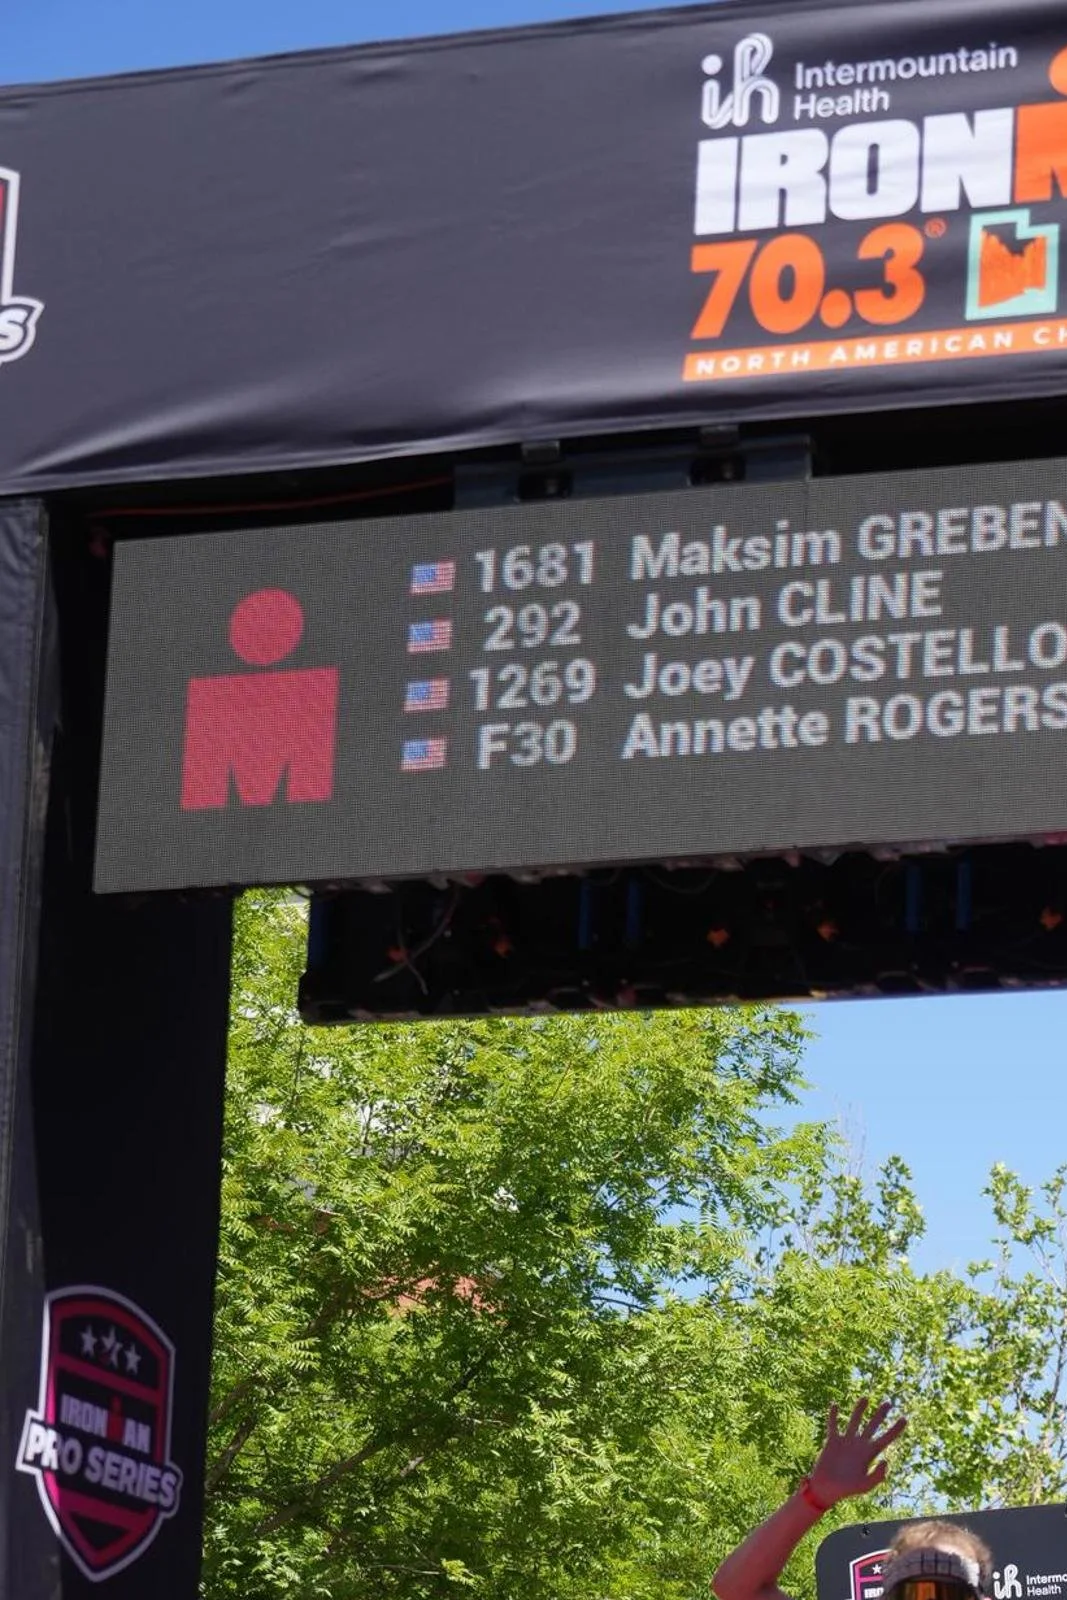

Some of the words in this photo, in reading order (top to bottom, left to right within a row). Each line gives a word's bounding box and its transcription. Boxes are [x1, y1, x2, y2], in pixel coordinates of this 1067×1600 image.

[794, 43, 1018, 90] Intermountain
[793, 88, 890, 120] Health
[690, 223, 925, 341] 70.3
[696, 349, 811, 376] NORTH
[829, 329, 1014, 364] AMERICAN
[475, 541, 596, 594] 1681
[629, 521, 841, 581] Maksim
[483, 601, 582, 653] 292
[626, 578, 760, 641] John
[777, 569, 944, 627] CLINE
[468, 659, 596, 712] 1269
[624, 651, 755, 704] Joey
[476, 720, 577, 771] F30
[621, 701, 830, 761] Annette
[61, 1393, 151, 1453] IRONMAN
[25, 1422, 83, 1476] PRO
[85, 1443, 178, 1508] SERIES
[1026, 1584, 1062, 1597] Health
